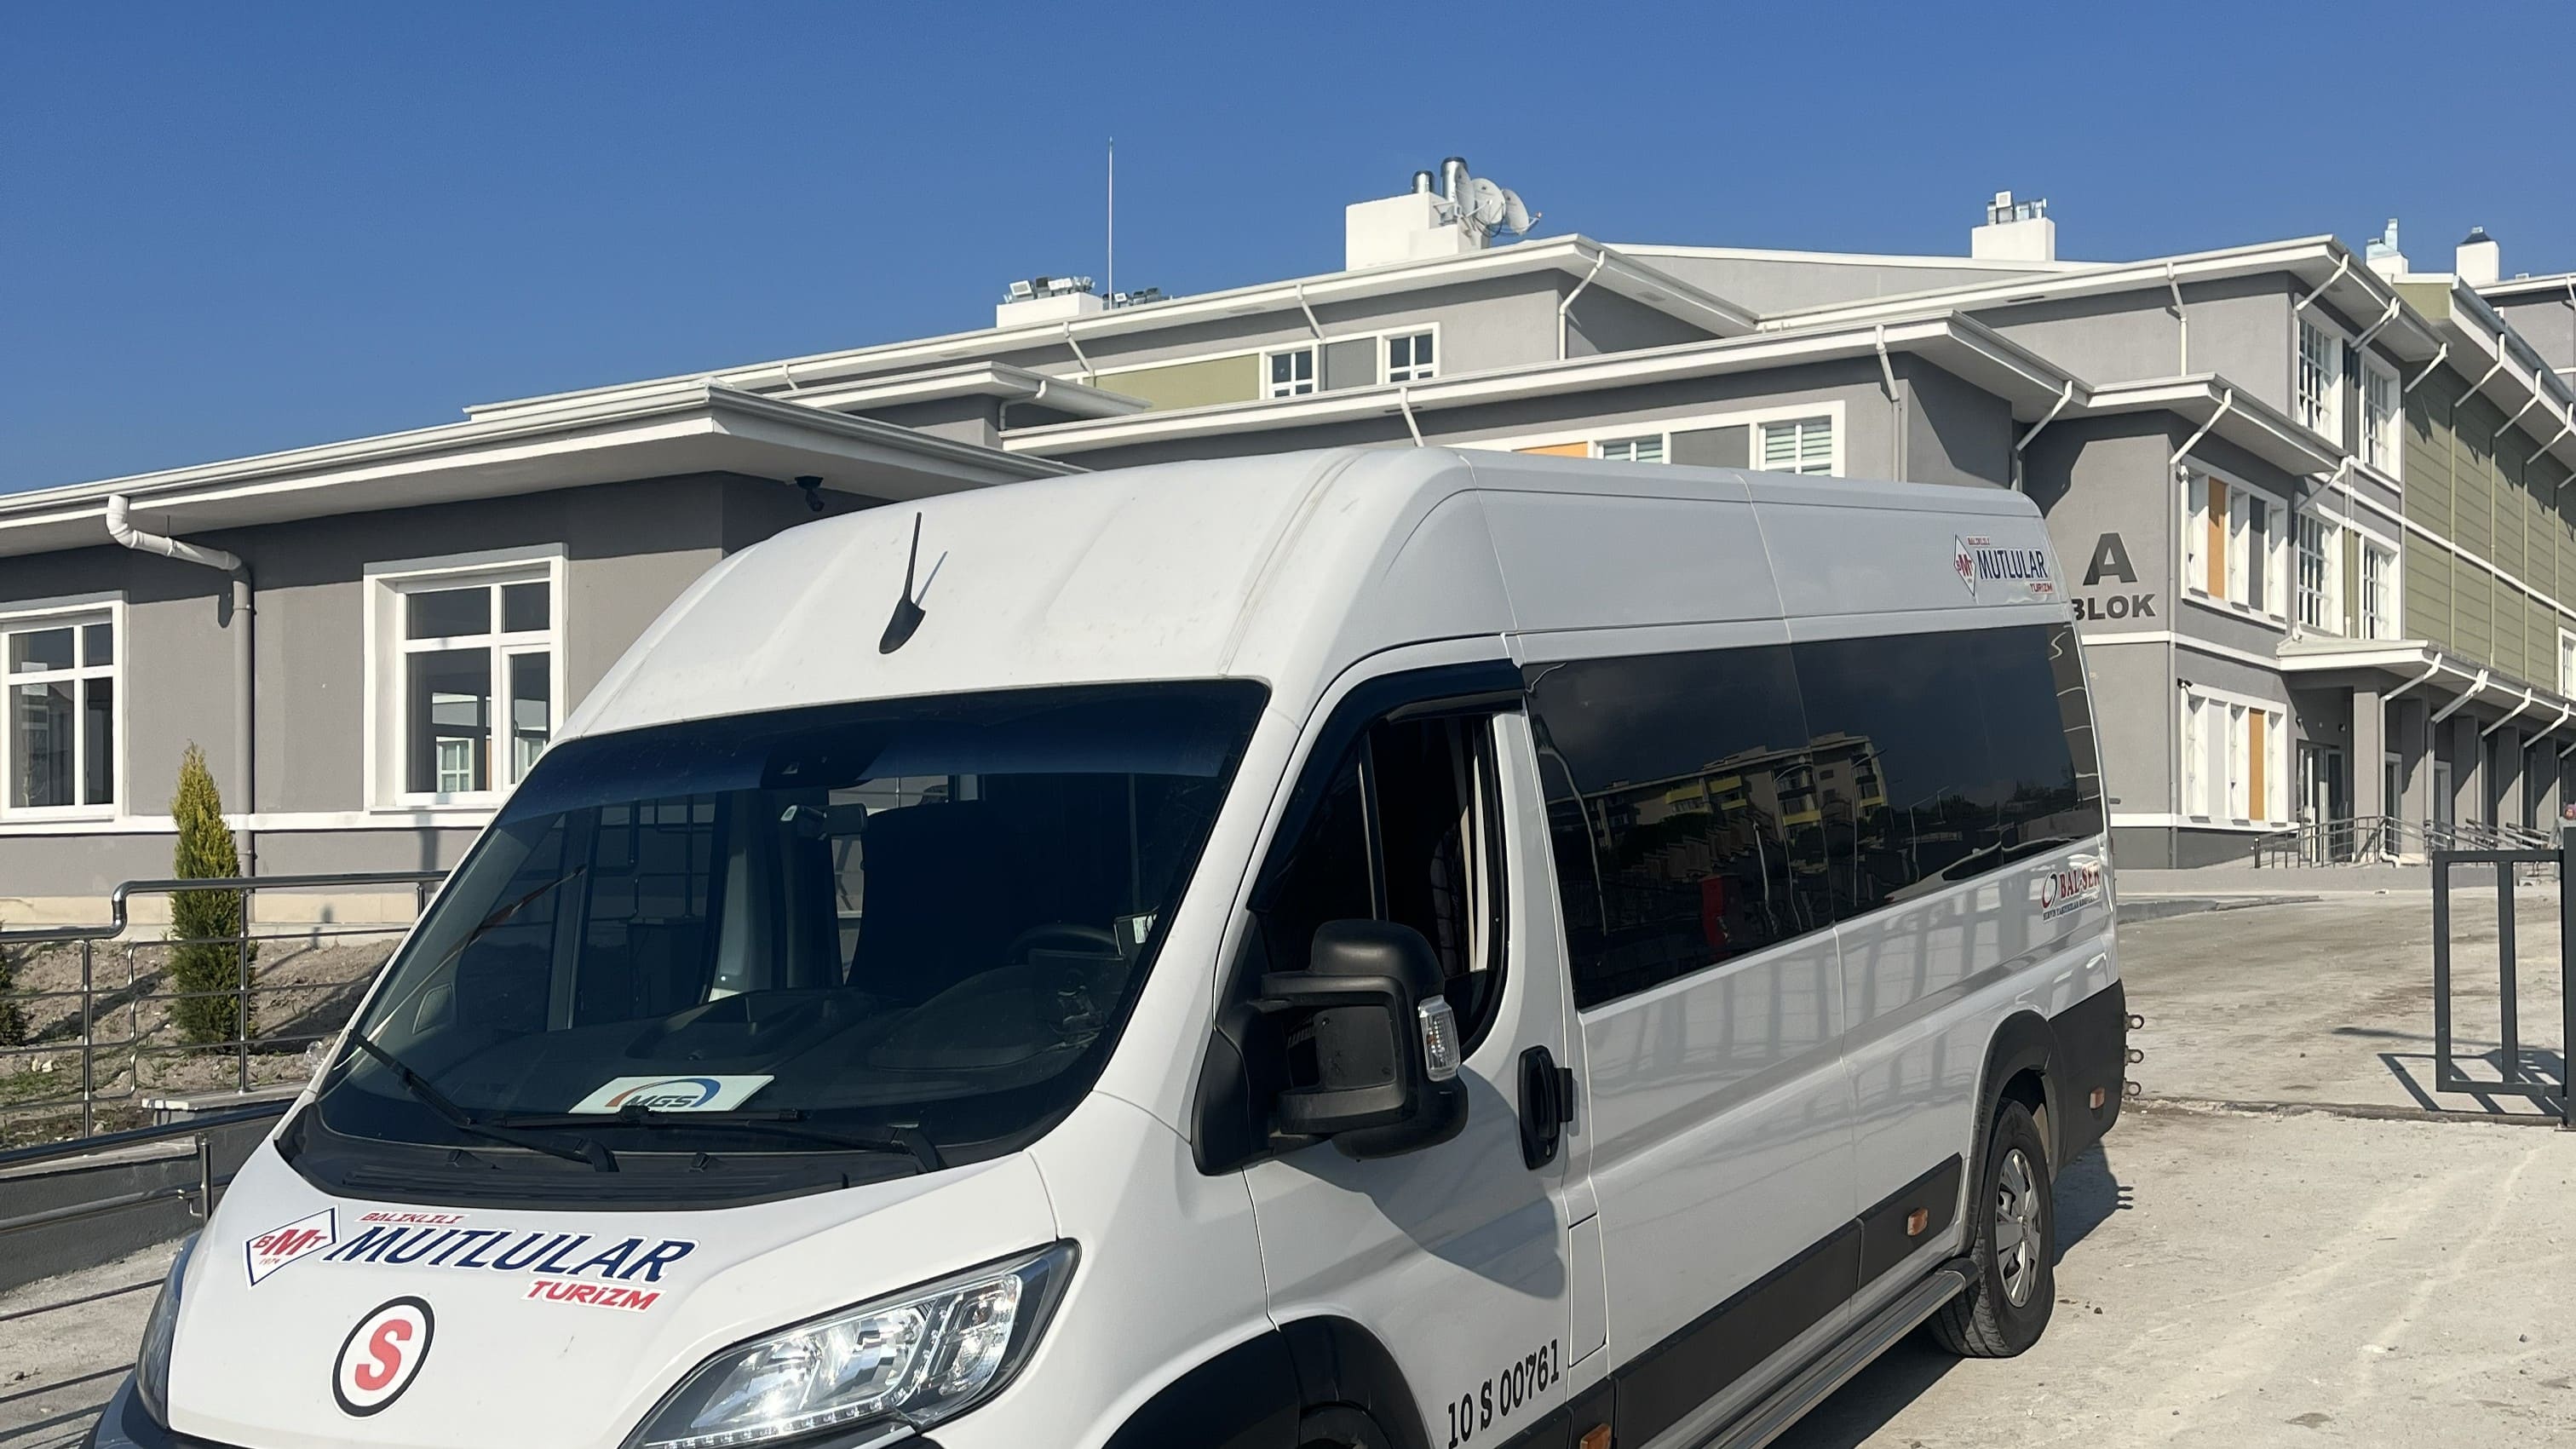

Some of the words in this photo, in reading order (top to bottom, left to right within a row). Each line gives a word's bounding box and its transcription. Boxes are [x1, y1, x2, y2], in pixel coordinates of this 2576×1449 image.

[1976, 549, 2048, 579] MUTLULAR
[2083, 532, 2137, 585] A
[2071, 594, 2156, 620] BLOK
[253, 1229, 328, 1256] BMT
[322, 1226, 696, 1283] MUTLULAR
[354, 1318, 413, 1391] S
[1448, 1392, 1474, 1449] 10
[1481, 1377, 1493, 1432] S
[1500, 1338, 1559, 1416] 00761
